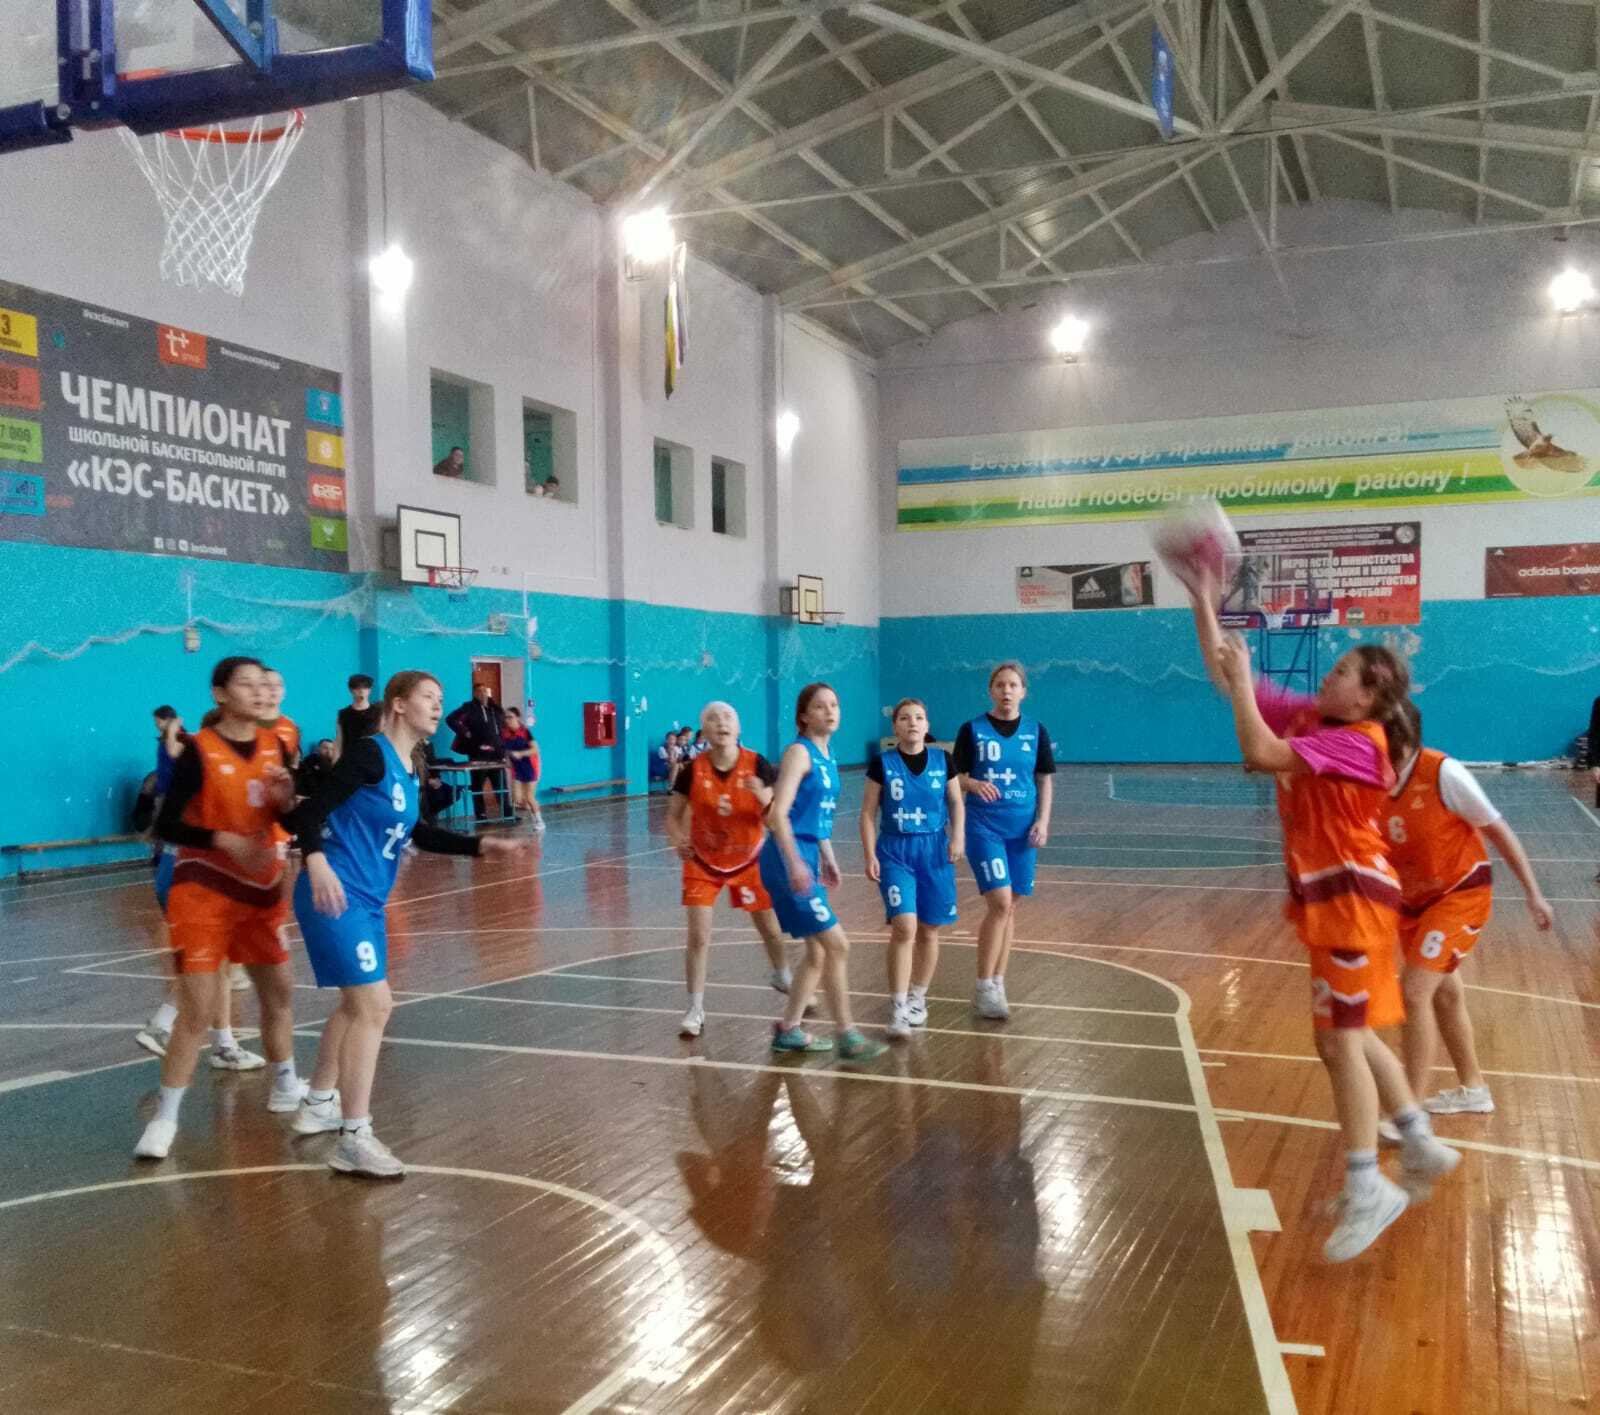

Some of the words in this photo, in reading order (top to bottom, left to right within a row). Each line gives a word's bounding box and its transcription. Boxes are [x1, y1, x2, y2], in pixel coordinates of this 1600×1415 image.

[60, 370, 291, 458] ЧЕМПИОНАТ
[68, 426, 149, 456] ШКОЛЬНОЙ
[152, 440, 254, 473] БАСКЕТБОЛЬНОЙ
[256, 458, 287, 479] ЛИГИ
[67, 455, 290, 517] «КЭС-БАСКЕТ»
[1017, 491, 1082, 511] Наши
[1088, 481, 1181, 507] победы
[1202, 474, 1341, 499] любимому
[1354, 466, 1453, 497] району
[1518, 566, 1560, 577] adidas
[976, 740, 1001, 763] 10
[392, 783, 407, 812] 9
[890, 778, 904, 801] 6
[1387, 815, 1407, 844] 6
[980, 857, 1006, 882] 10
[740, 886, 756, 905] 5
[809, 897, 831, 923] 5
[887, 885, 901, 908] 6
[355, 941, 378, 973] 9
[1420, 930, 1446, 960] 6
